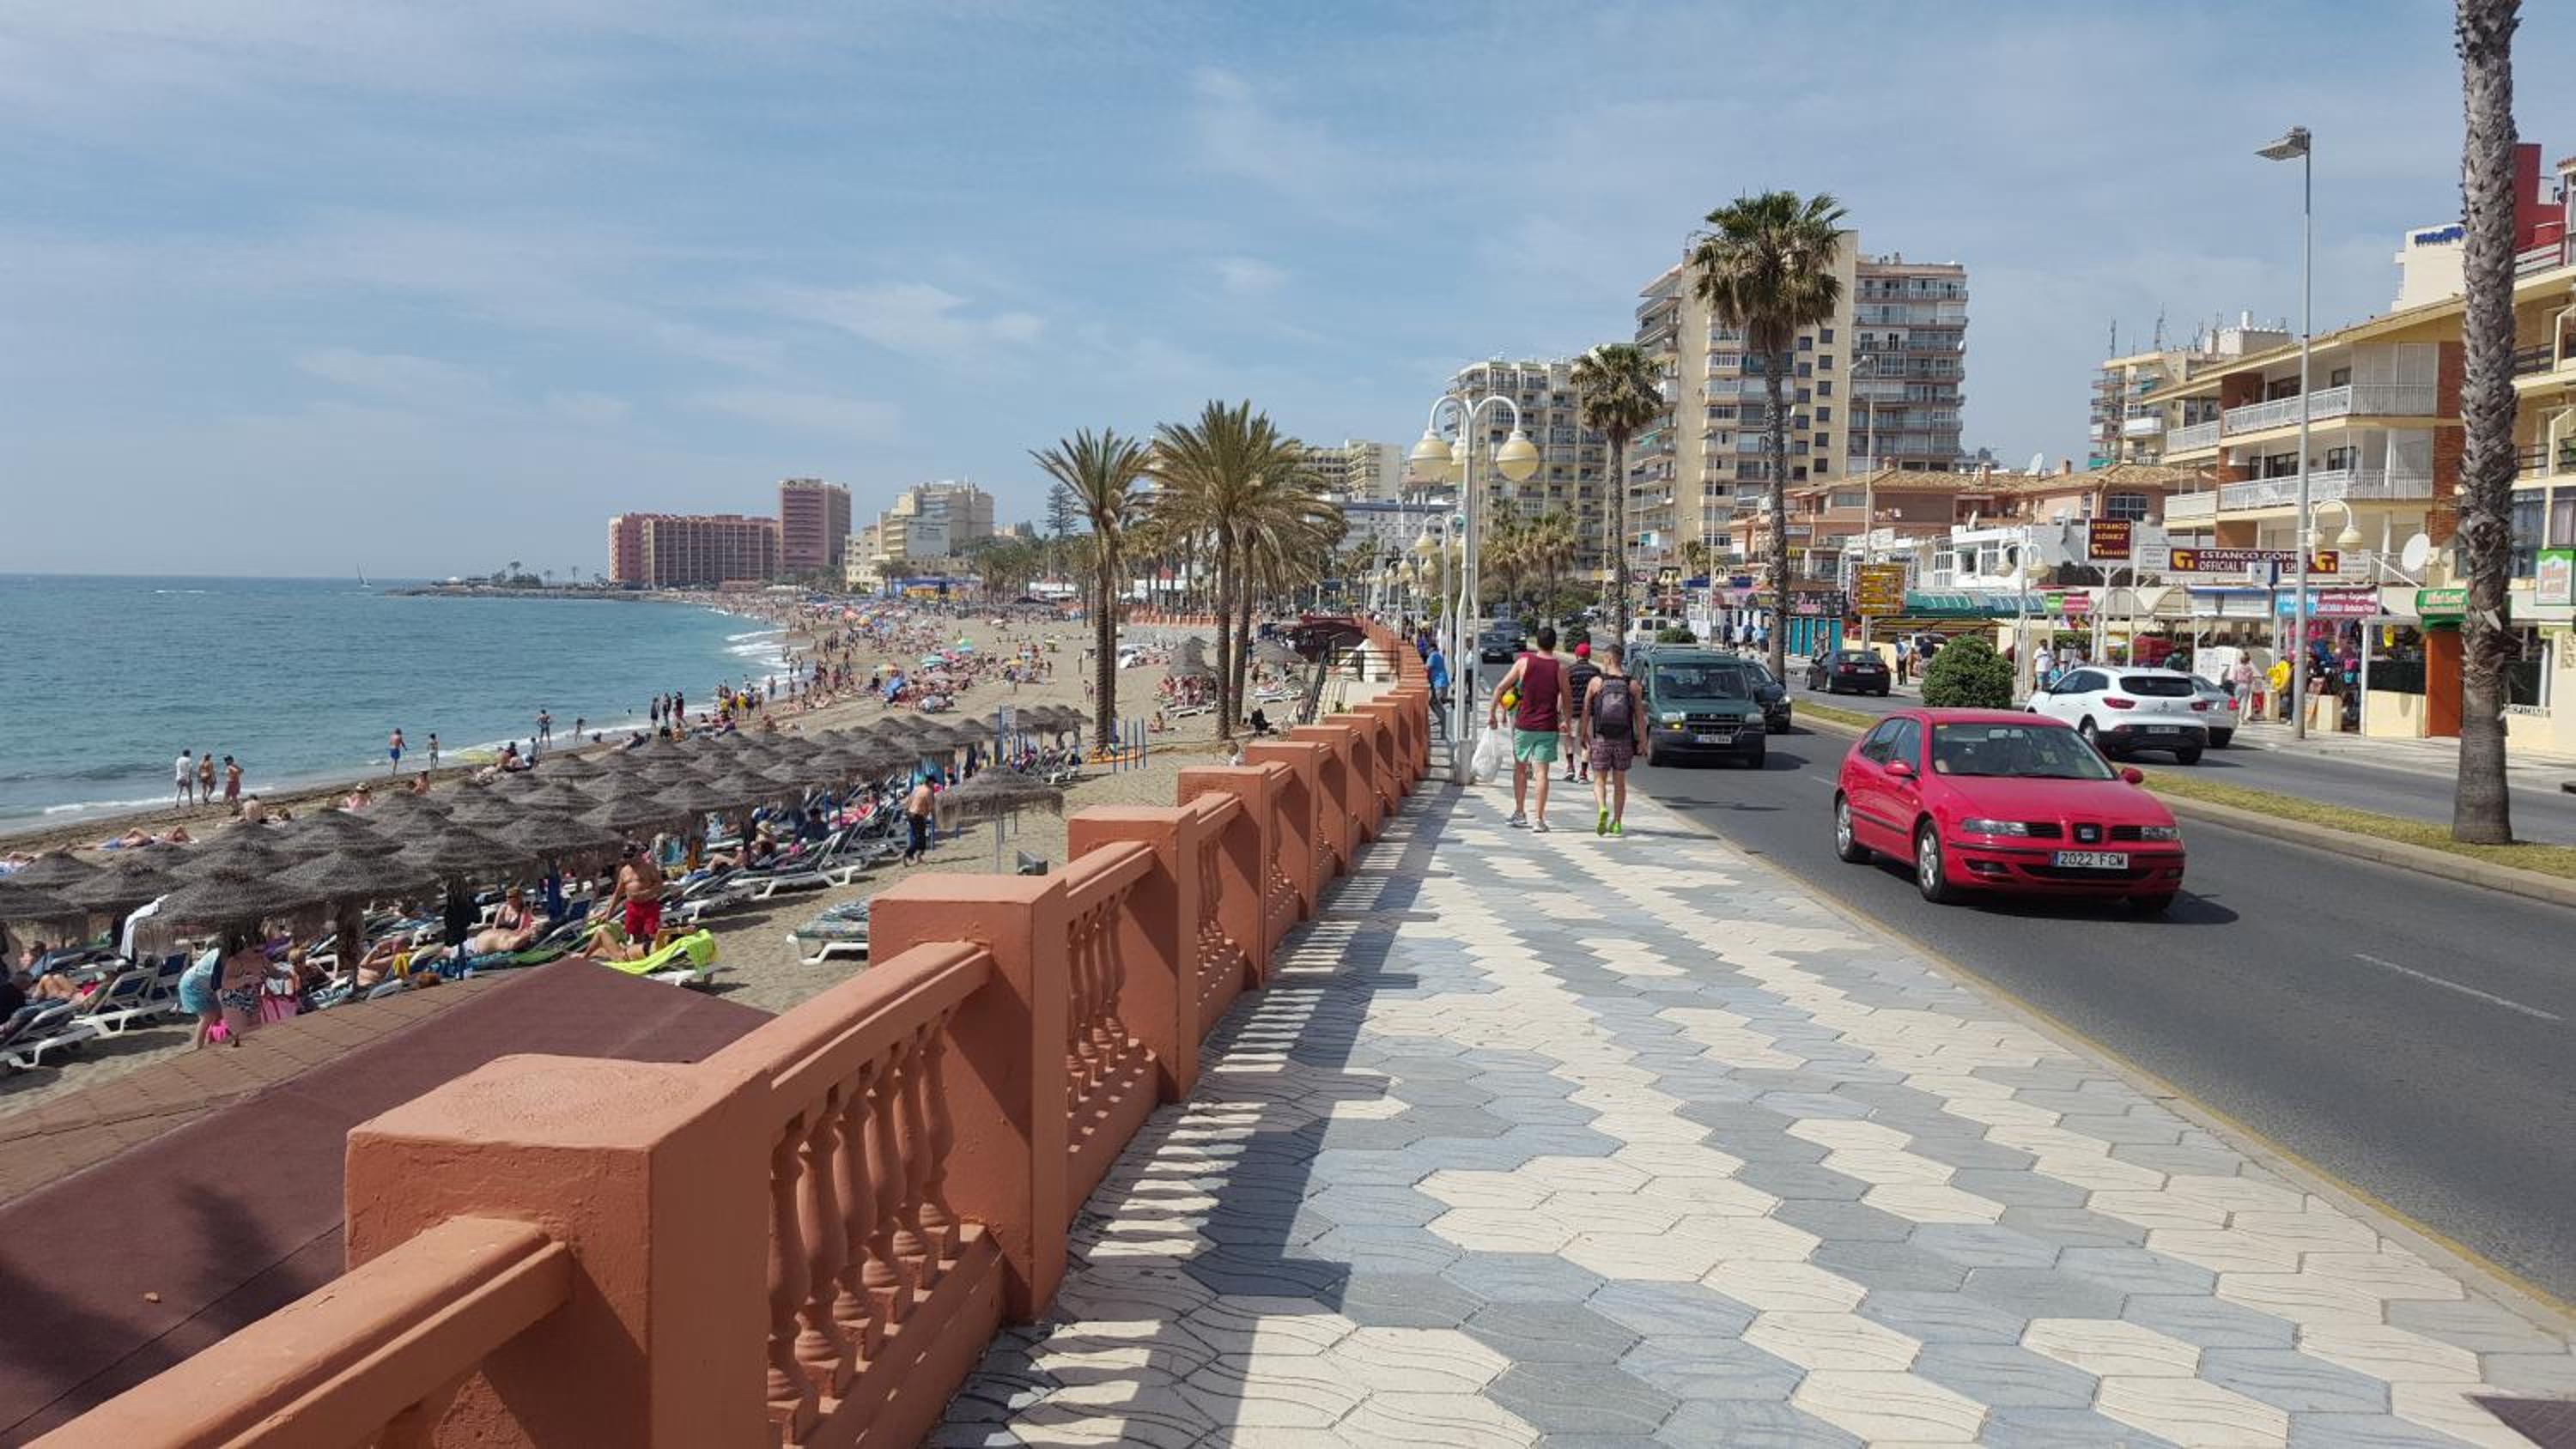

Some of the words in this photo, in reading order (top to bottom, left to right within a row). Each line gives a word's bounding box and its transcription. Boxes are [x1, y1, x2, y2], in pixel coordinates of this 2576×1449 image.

[2199, 550, 2259, 561] ESTANCO
[2263, 549, 2294, 561] GÓM
[2199, 561, 2239, 572] OFFICIAL
[2060, 852, 2093, 866] 2022
